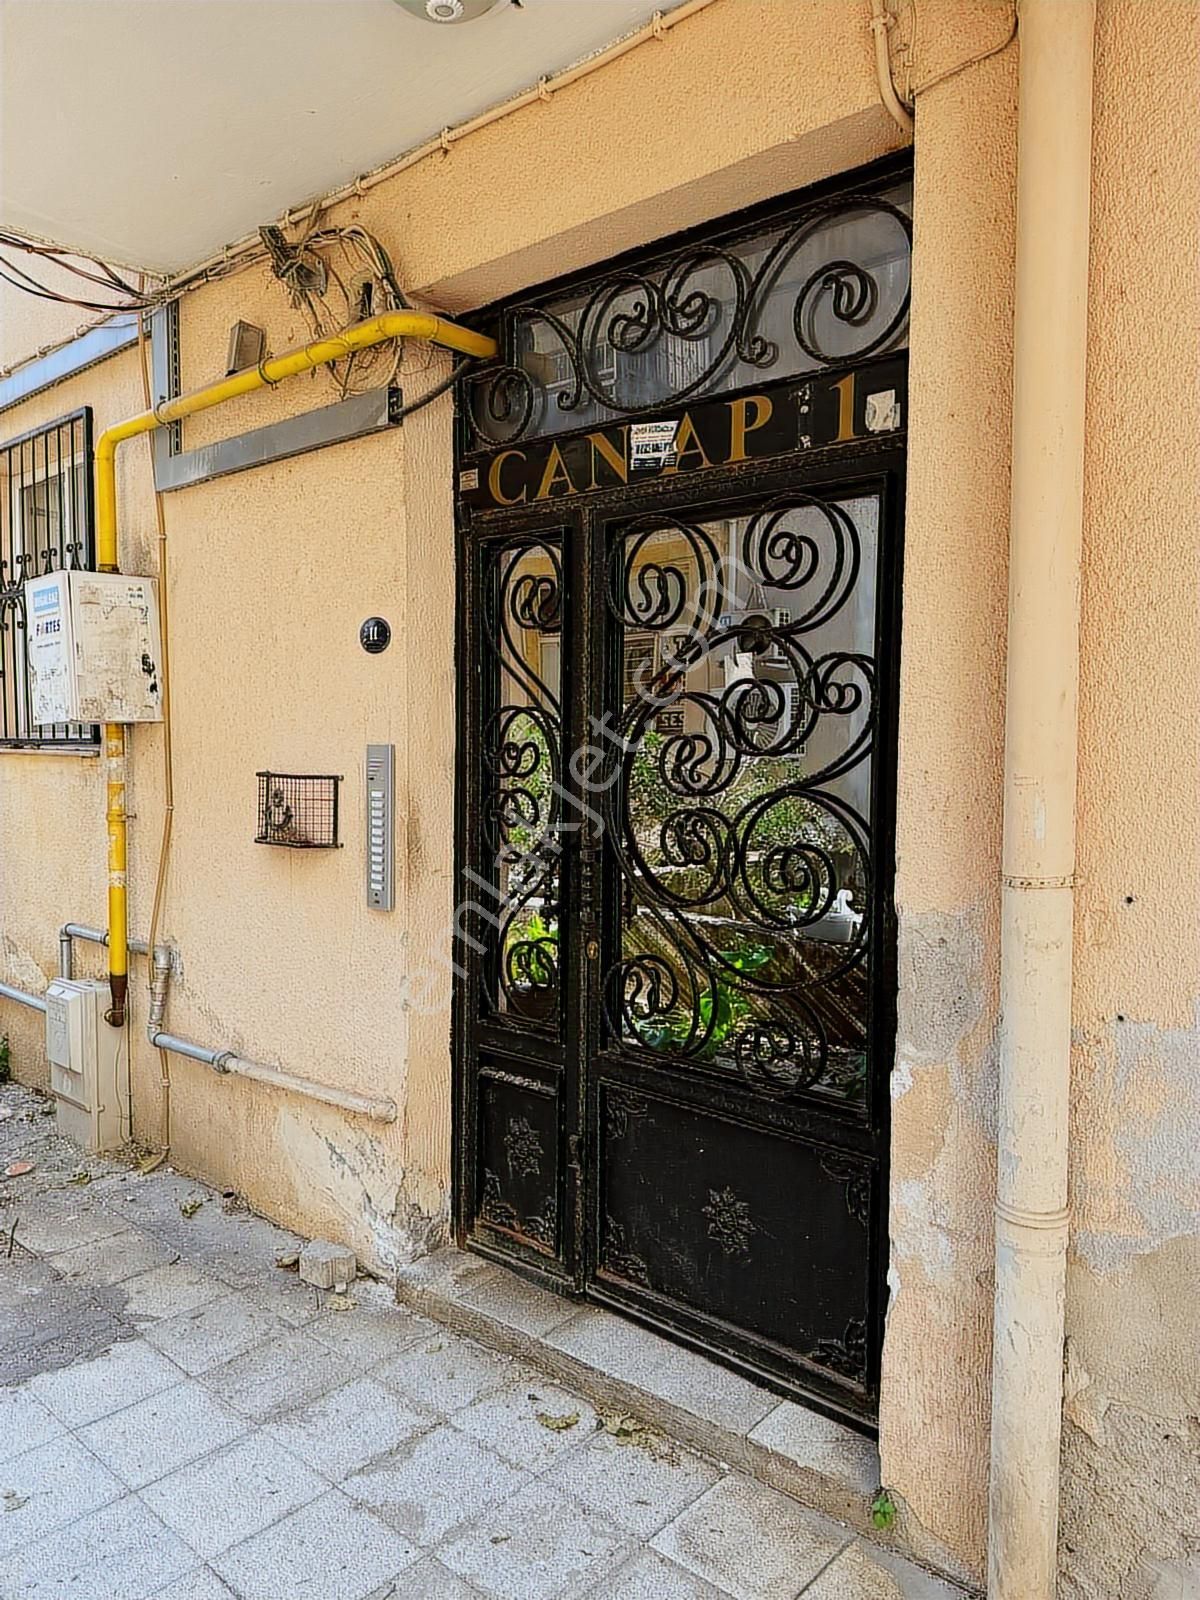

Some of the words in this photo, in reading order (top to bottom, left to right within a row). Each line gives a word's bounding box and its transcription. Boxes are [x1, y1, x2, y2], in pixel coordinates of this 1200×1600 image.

[488, 425, 629, 505] CAN
[662, 395, 773, 474] AP
[828, 372, 859, 443] 1
